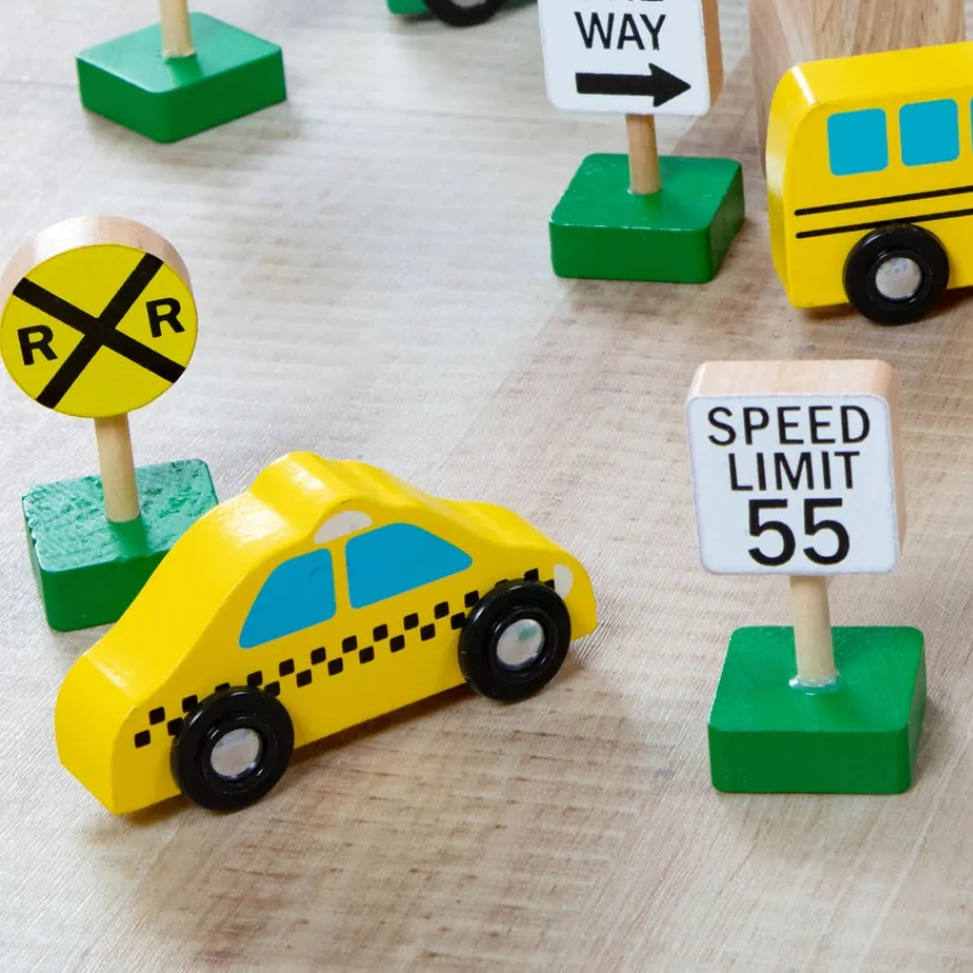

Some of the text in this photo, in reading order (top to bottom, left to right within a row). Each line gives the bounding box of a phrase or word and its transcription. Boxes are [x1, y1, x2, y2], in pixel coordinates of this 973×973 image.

[574, 11, 666, 51] WAY
[17, 297, 186, 366] R R
[707, 405, 870, 446] SPEED
[728, 451, 860, 491] LIMIT
[748, 497, 850, 566] 55
